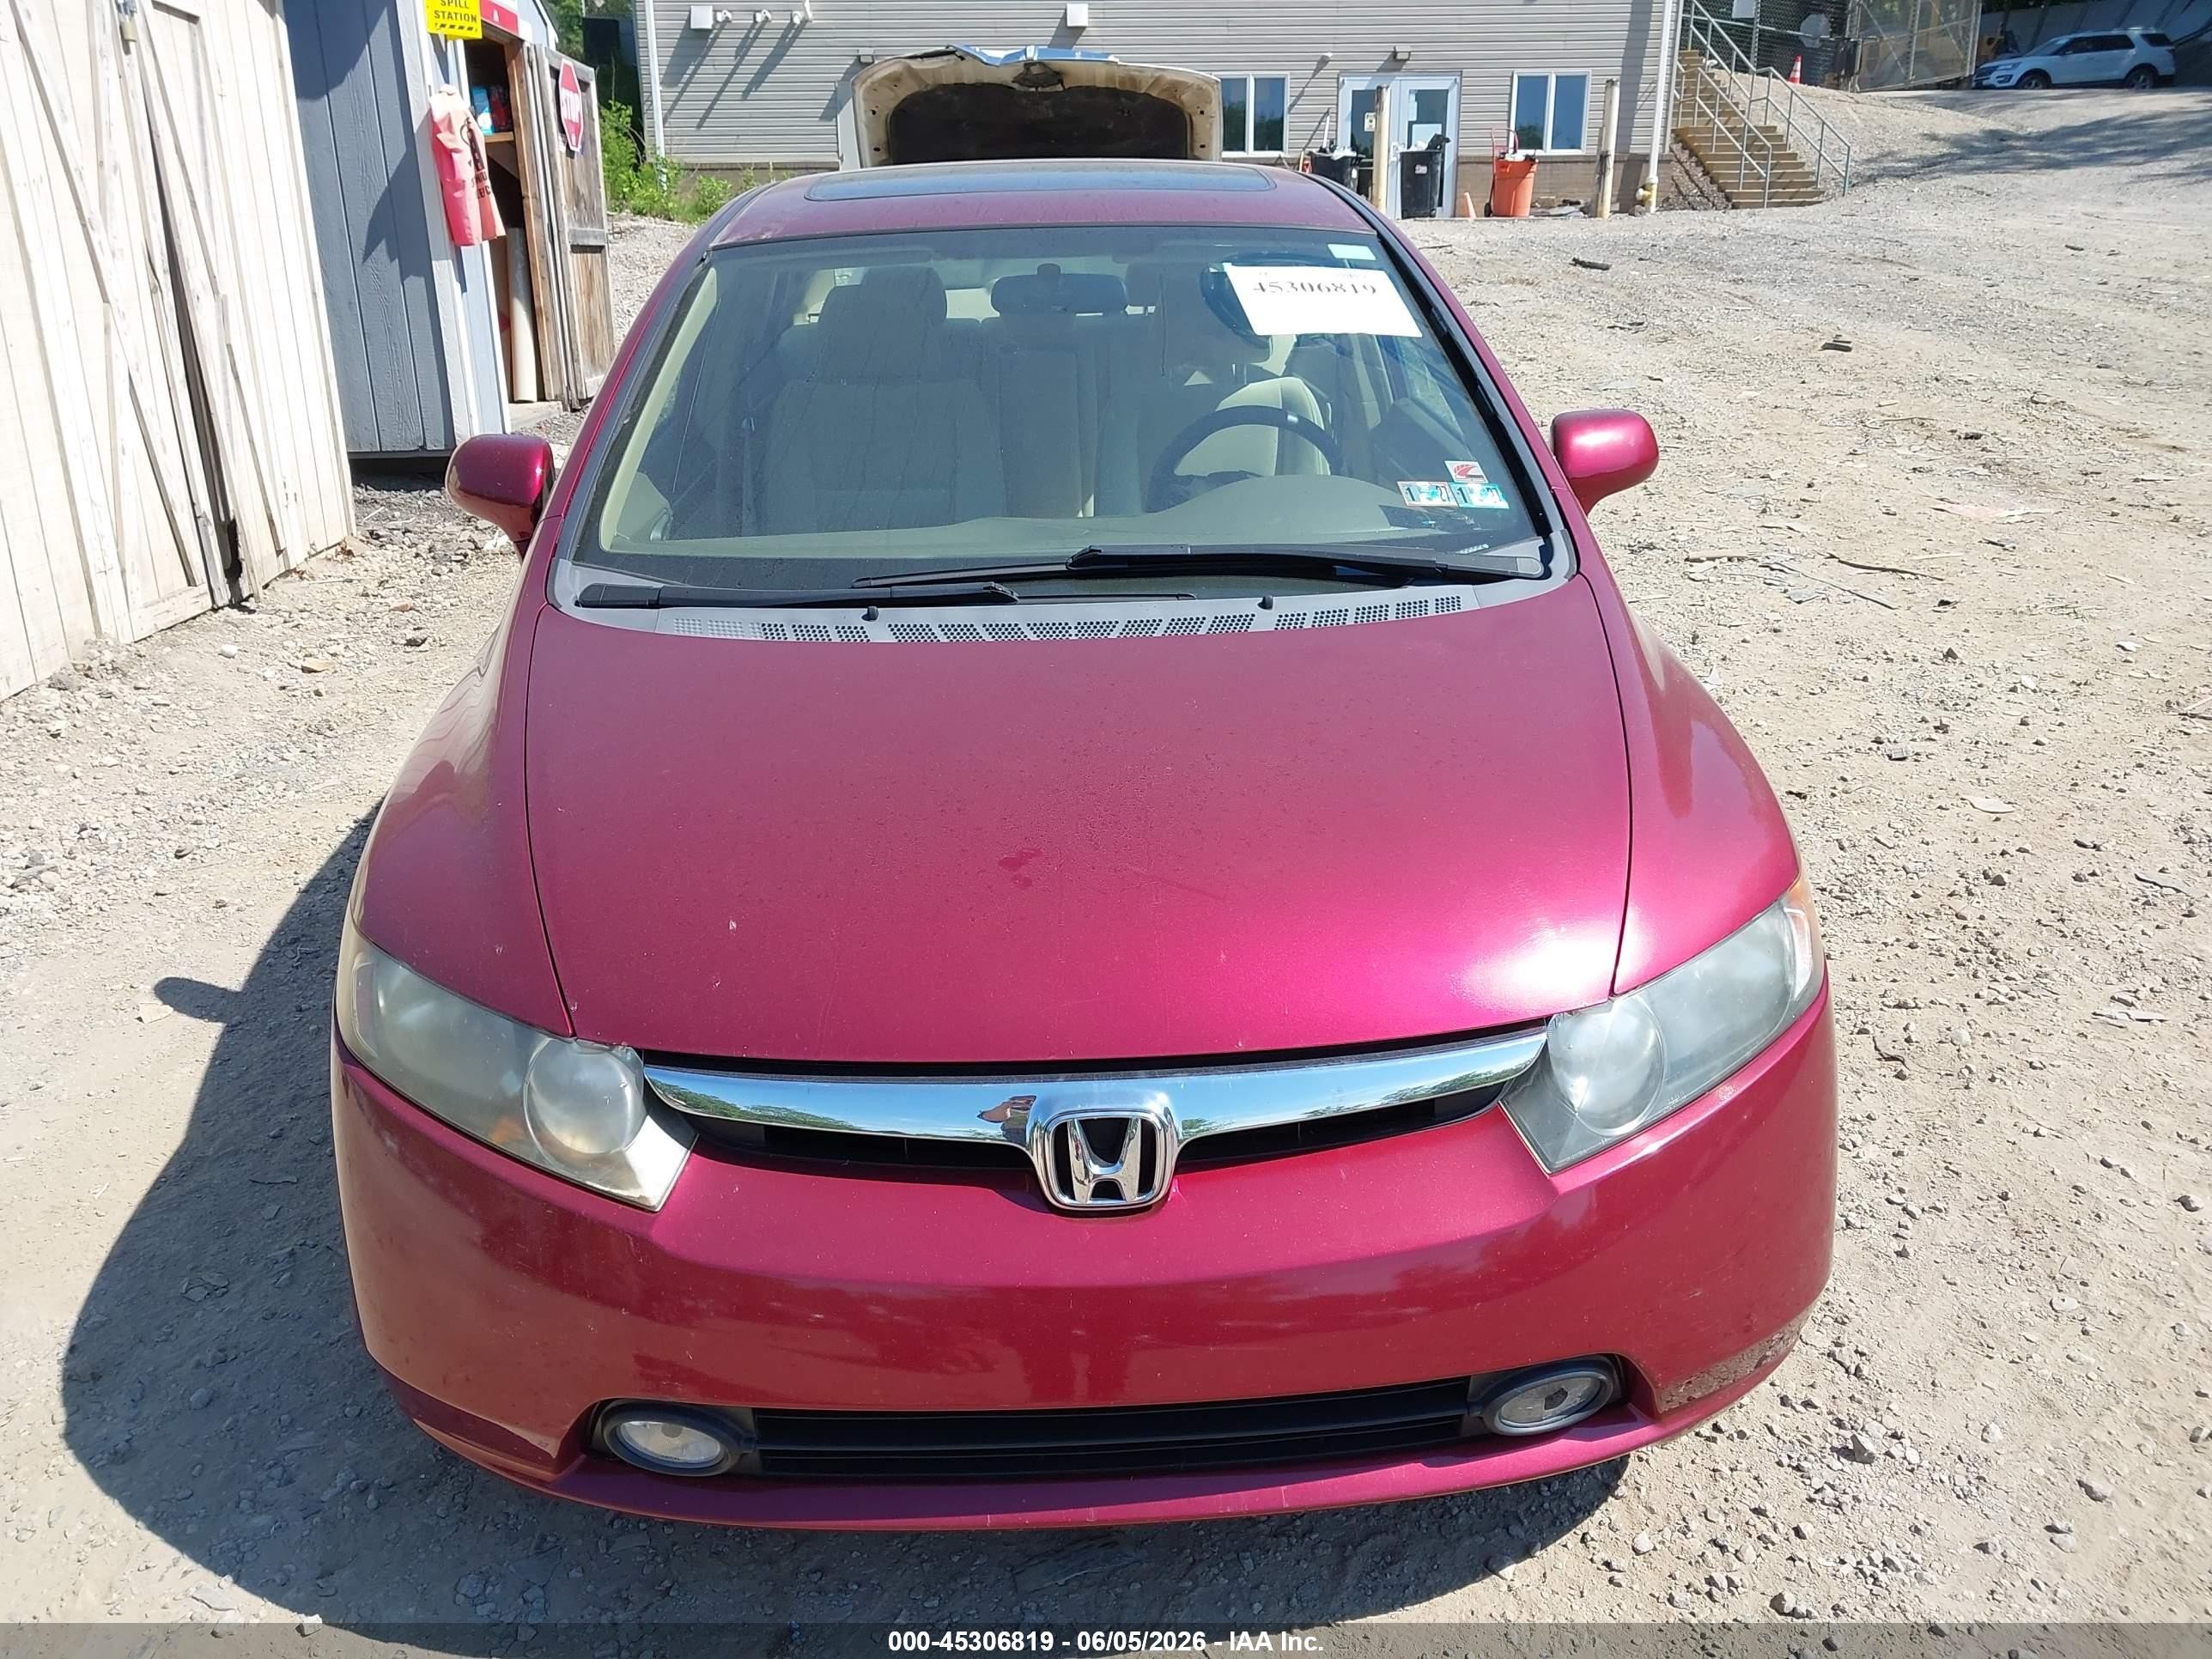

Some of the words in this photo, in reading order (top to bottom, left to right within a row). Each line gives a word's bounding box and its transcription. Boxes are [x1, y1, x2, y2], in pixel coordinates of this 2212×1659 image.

[440, 0, 470, 9] SPILL
[434, 9, 477, 23] STATION
[1252, 281, 1377, 295] 45306819
